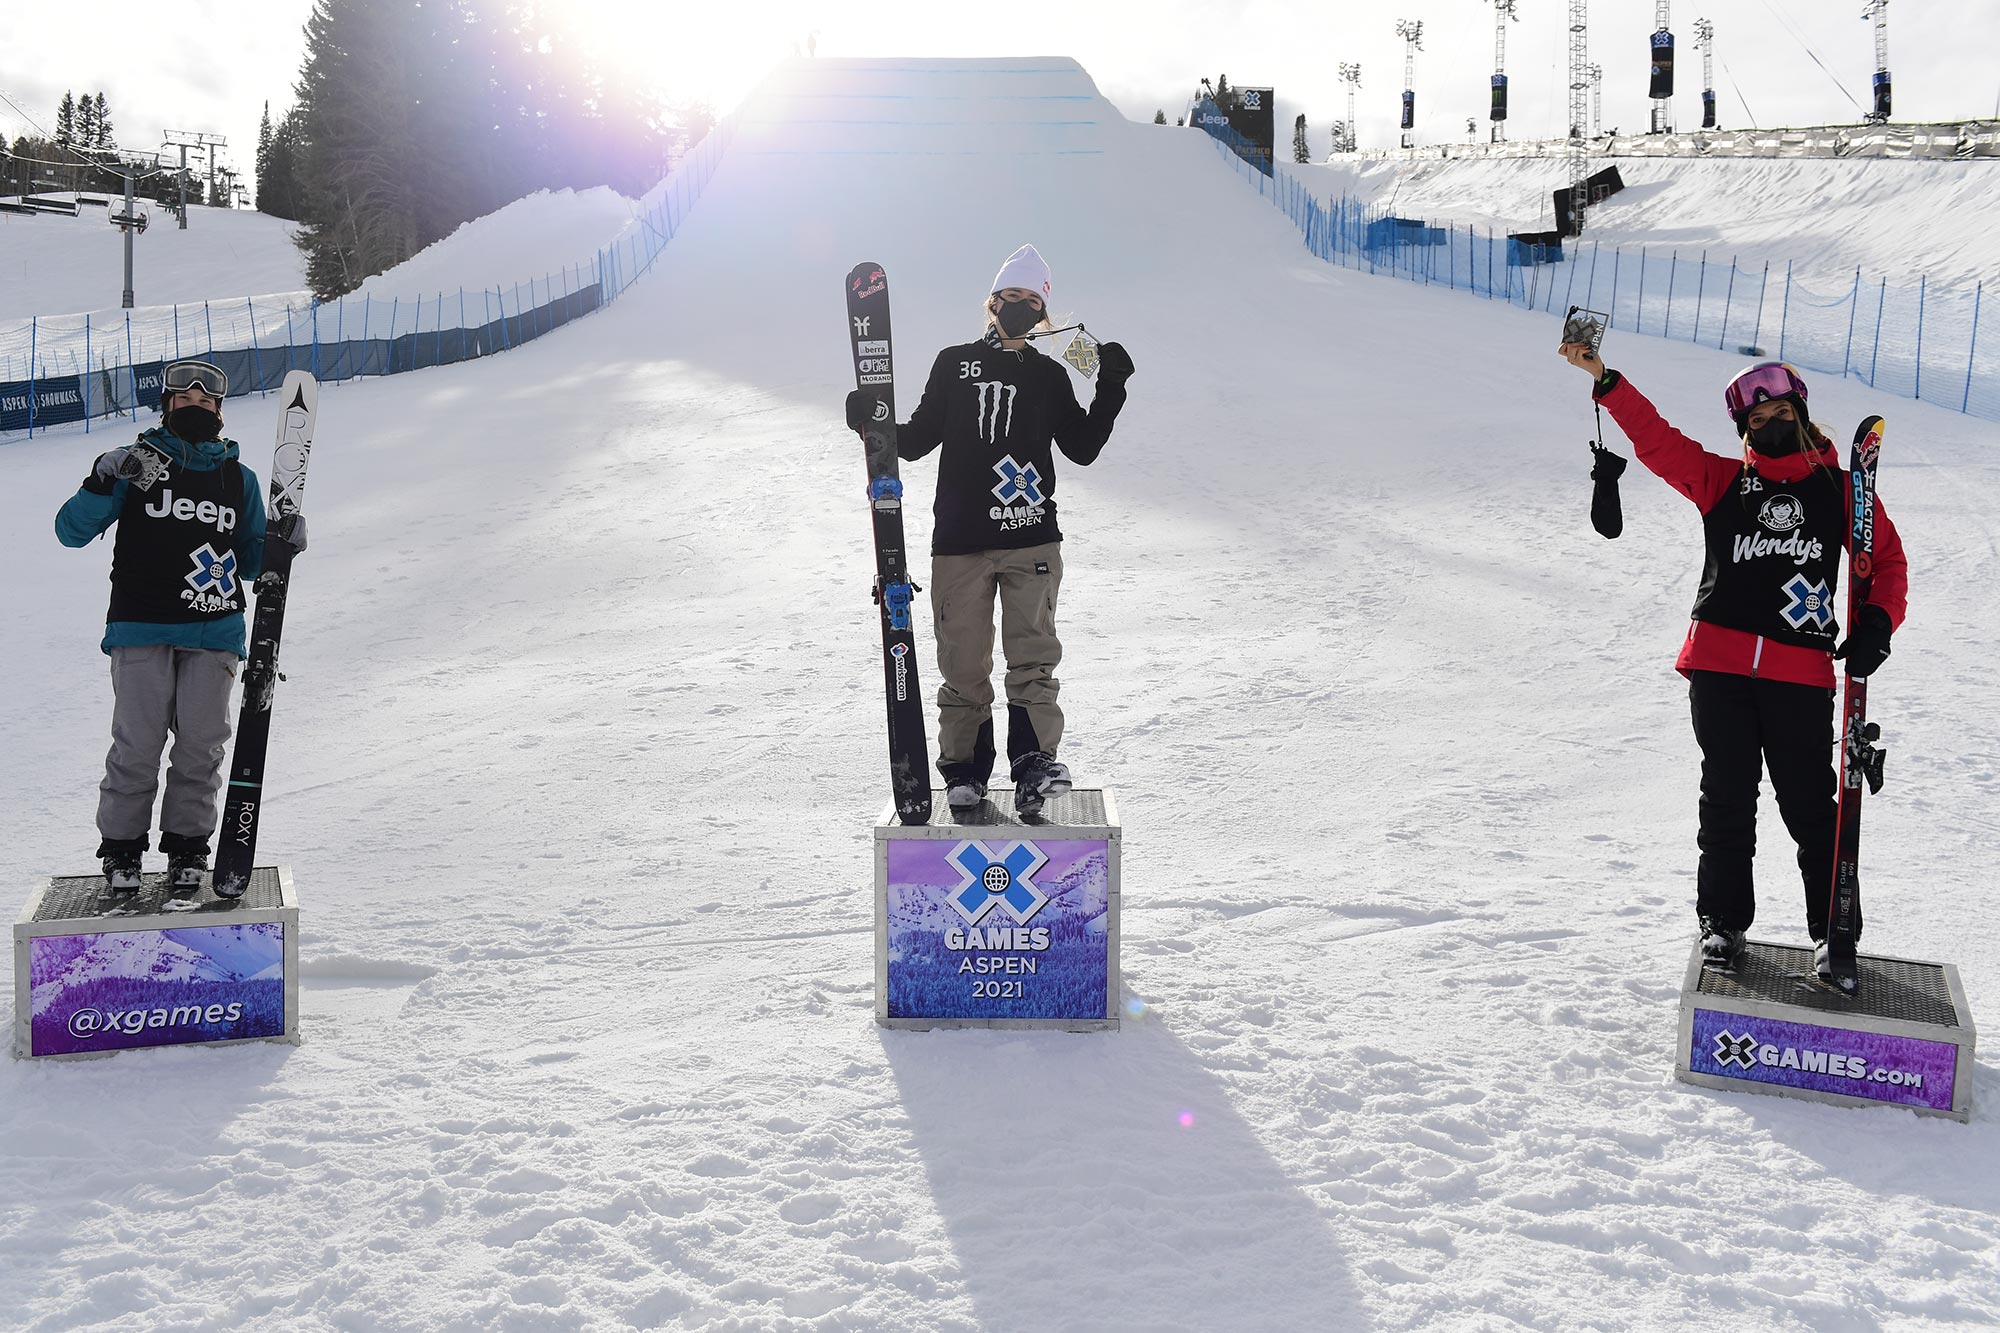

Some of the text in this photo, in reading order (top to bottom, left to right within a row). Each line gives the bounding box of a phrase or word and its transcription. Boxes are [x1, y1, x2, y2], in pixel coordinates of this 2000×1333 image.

[1197, 113, 1230, 126] Jeep
[959, 361, 982, 379] 36
[138, 375, 160, 390] ASPEN
[2, 389, 79, 412] ASPEN SNOWMASS
[145, 488, 236, 533] Jeep
[989, 505, 1046, 521] GAMES
[1000, 515, 1043, 531] ASPEN
[1863, 490, 1875, 553] FACTION
[1733, 528, 1823, 566] Wendy's
[187, 600, 233, 613] ASP
[897, 656, 908, 700] swisscom
[236, 801, 255, 847] ROXY
[944, 927, 1050, 951] GAMES
[959, 956, 1037, 975] ASPEN
[972, 980, 1024, 999] 2021
[68, 1001, 244, 1039] @xgames
